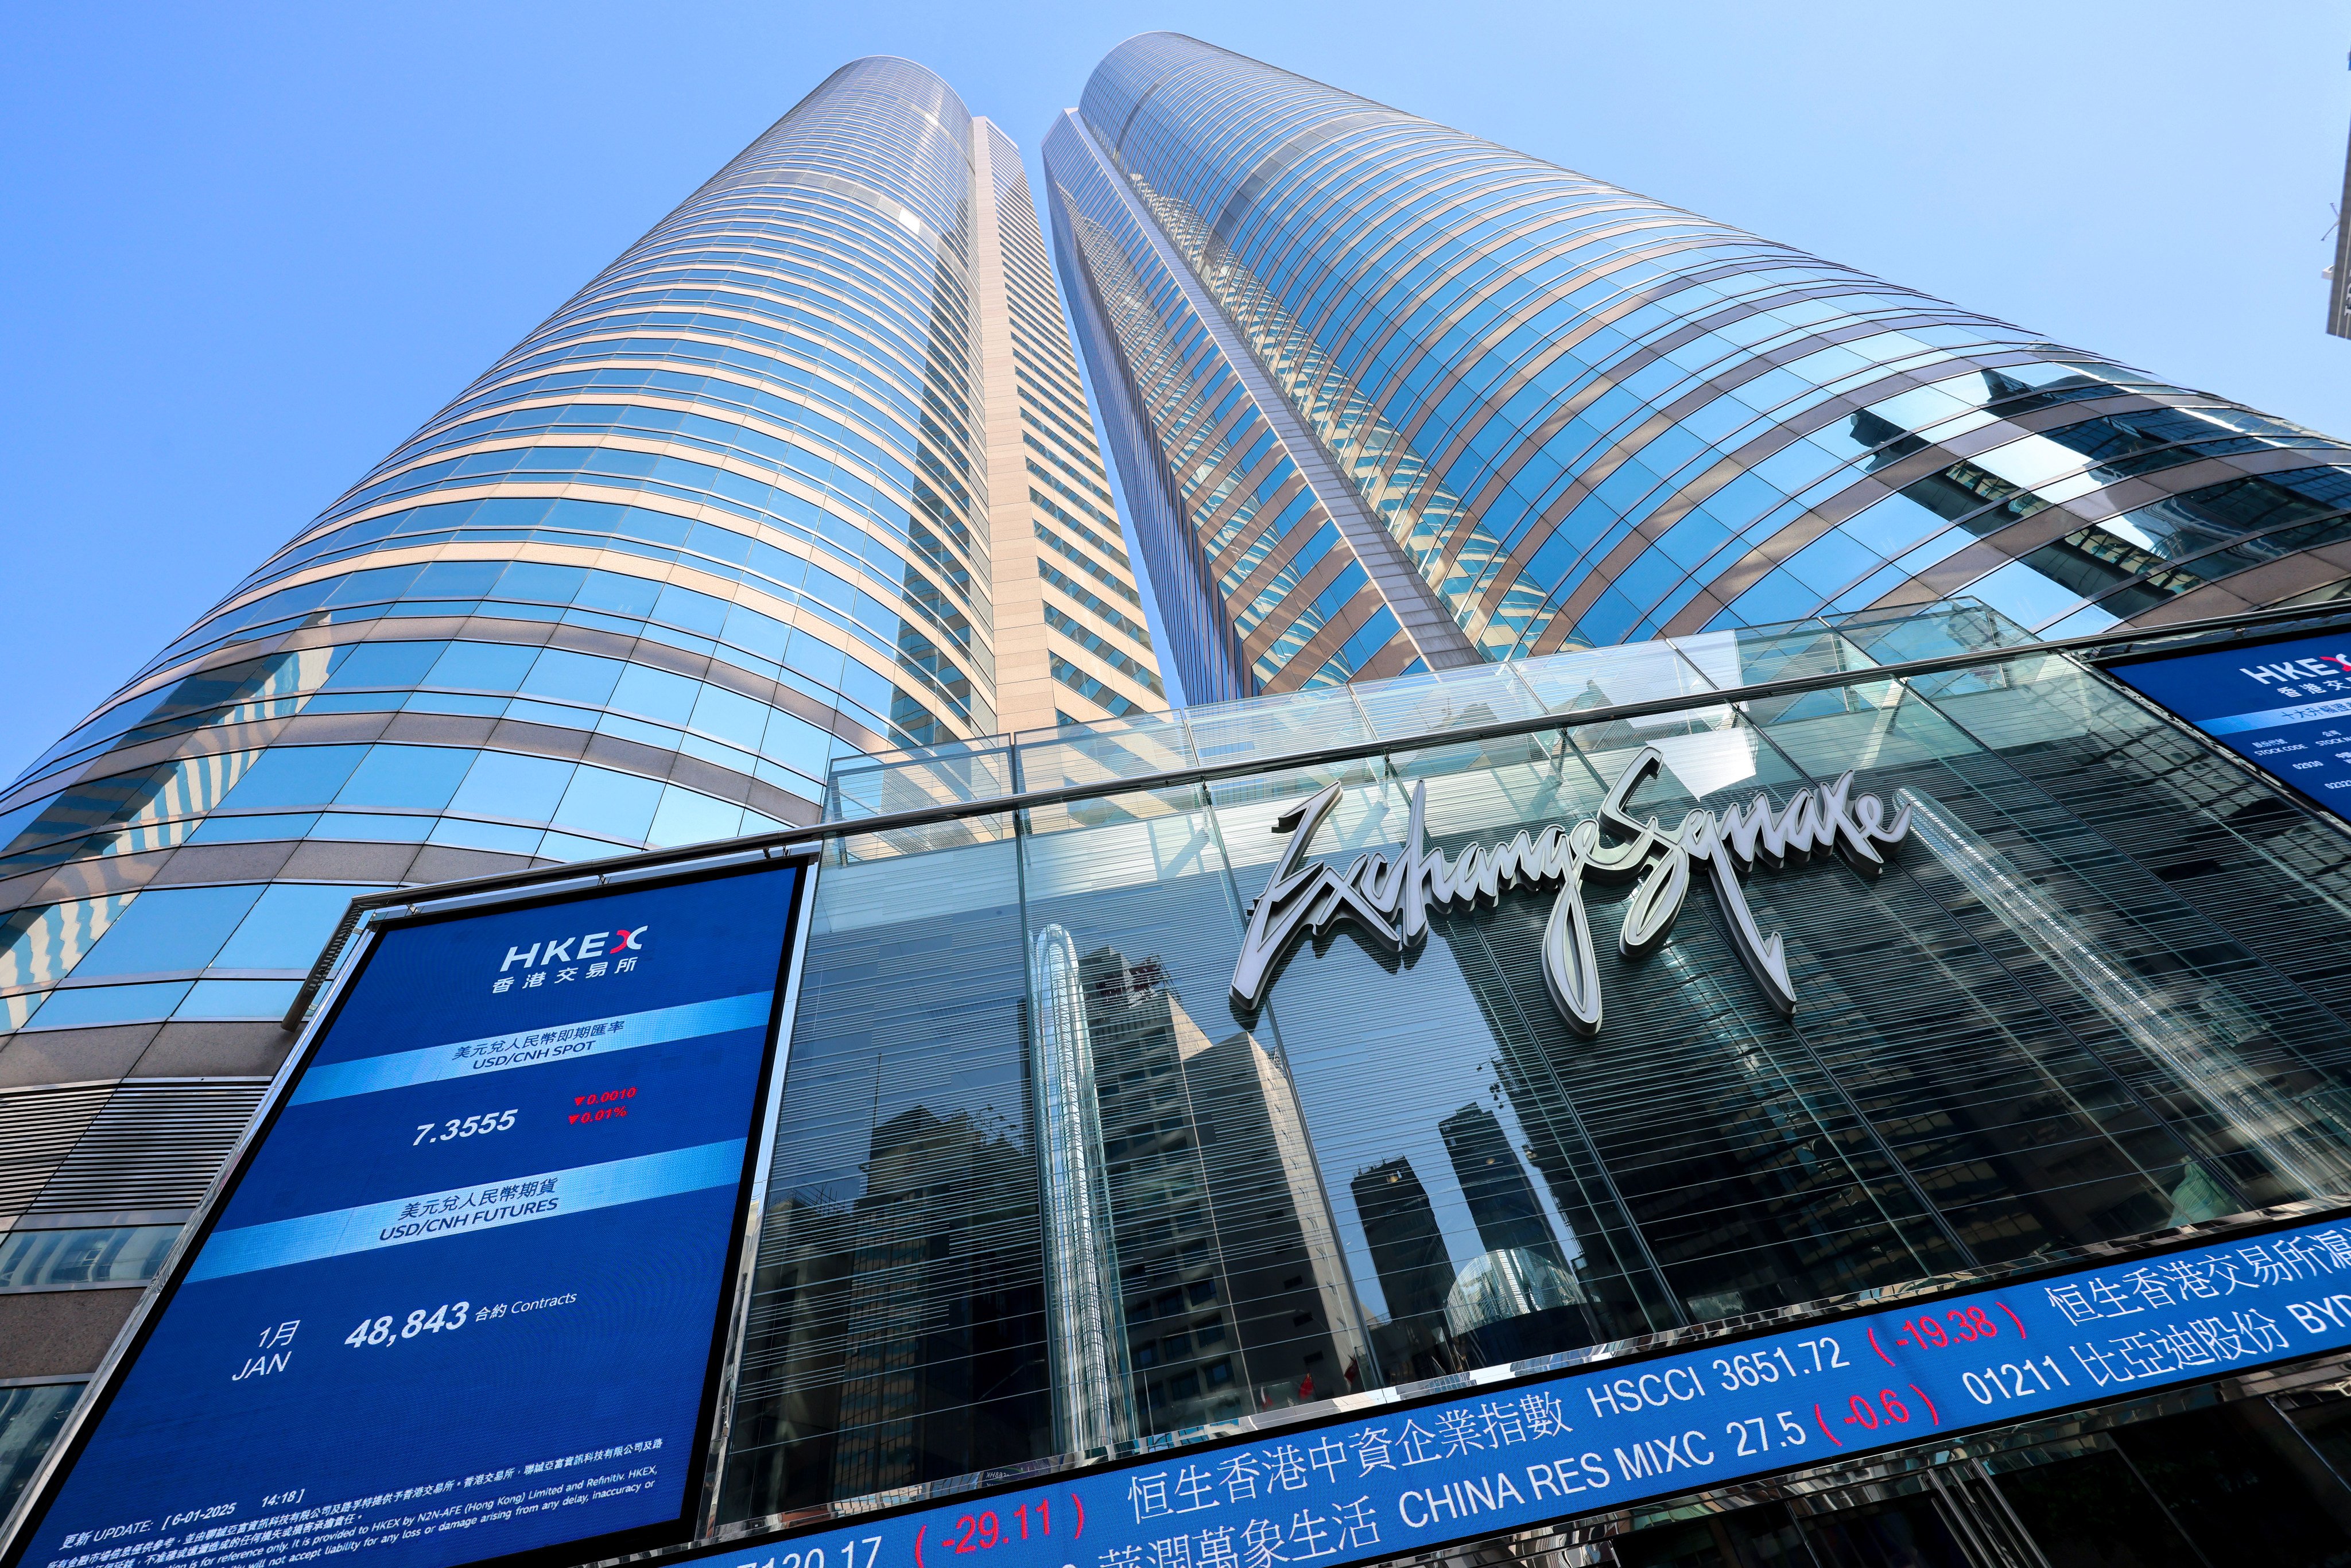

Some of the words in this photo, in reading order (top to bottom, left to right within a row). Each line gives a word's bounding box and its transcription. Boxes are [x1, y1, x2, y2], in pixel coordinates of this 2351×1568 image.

[2277, 677, 2351, 697] 香港交
[2254, 747, 2284, 756] STOCK
[2315, 738, 2345, 746] STOCK
[2292, 760, 2323, 769] 02930
[1228, 778, 1624, 1035] Exchange
[1597, 746, 1914, 1021] Square
[499, 925, 648, 972] HKEX
[492, 956, 638, 994] 香港交易所
[452, 1020, 624, 1061] 美元兌人民幣即期匯率
[472, 1049, 549, 1070] USD/CNH
[552, 1039, 595, 1057] SPOT
[581, 1105, 628, 1123] 0.01%
[587, 1086, 637, 1105] 0.0010
[413, 1109, 518, 1146] 7.3555
[398, 1178, 558, 1221] 美元兌人民幣期貨
[379, 1214, 468, 1241] USD/CNH
[472, 1197, 558, 1226] FUTURES
[257, 1319, 301, 1349] 1月
[345, 1301, 470, 1349] 48,843
[475, 1302, 507, 1324] 合約
[511, 1290, 577, 1315] Contracts
[232, 1350, 292, 1381] JAN
[1127, 1390, 1573, 1524] 恒生香港中資企業指數
[1586, 1366, 1706, 1418] HSCCI
[1713, 1337, 1850, 1392] 3651.72
[2044, 1225, 2351, 1327] 恒生香港交易所滬
[1398, 1471, 1526, 1528] CHINA
[1526, 1451, 1611, 1500] RES
[1613, 1430, 1714, 1481] MIXC
[1726, 1410, 1807, 1458] 27.5
[1962, 1355, 2071, 1406] 01211
[2069, 1308, 2290, 1387] 比亞迪股份
[59, 1530, 94, 1551] 更新
[93, 1520, 154, 1542] UPDATE:
[200, 1557, 216, 1567] for
[217, 1547, 264, 1564] reference
[266, 1541, 288, 1554] only.
[292, 1539, 300, 1549] It
[302, 1537, 311, 1547] is
[312, 1526, 356, 1546] provided
[358, 1525, 369, 1535] to
[371, 1517, 401, 1532] HKEX
[402, 1515, 415, 1527] by
[417, 1505, 463, 1523] N2N-AFE
[464, 1500, 494, 1514] (Hong
[497, 1492, 526, 1506] Kong)
[528, 1484, 564, 1499] Limited
[565, 1480, 584, 1492] and
[269, 1555, 287, 1567] not
[288, 1548, 323, 1563] accept
[325, 1540, 362, 1555] liability
[363, 1536, 379, 1547] for
[381, 1532, 399, 1544] any
[402, 1527, 421, 1539] loss
[424, 1524, 436, 1535] or
[439, 1516, 478, 1532] damage
[480, 1509, 512, 1523] arising
[515, 1504, 538, 1516] from
[542, 1499, 560, 1511] any
[562, 1492, 589, 1507] delay,
[592, 1482, 641, 1500] inaccuracy
[645, 1480, 655, 1489] or
